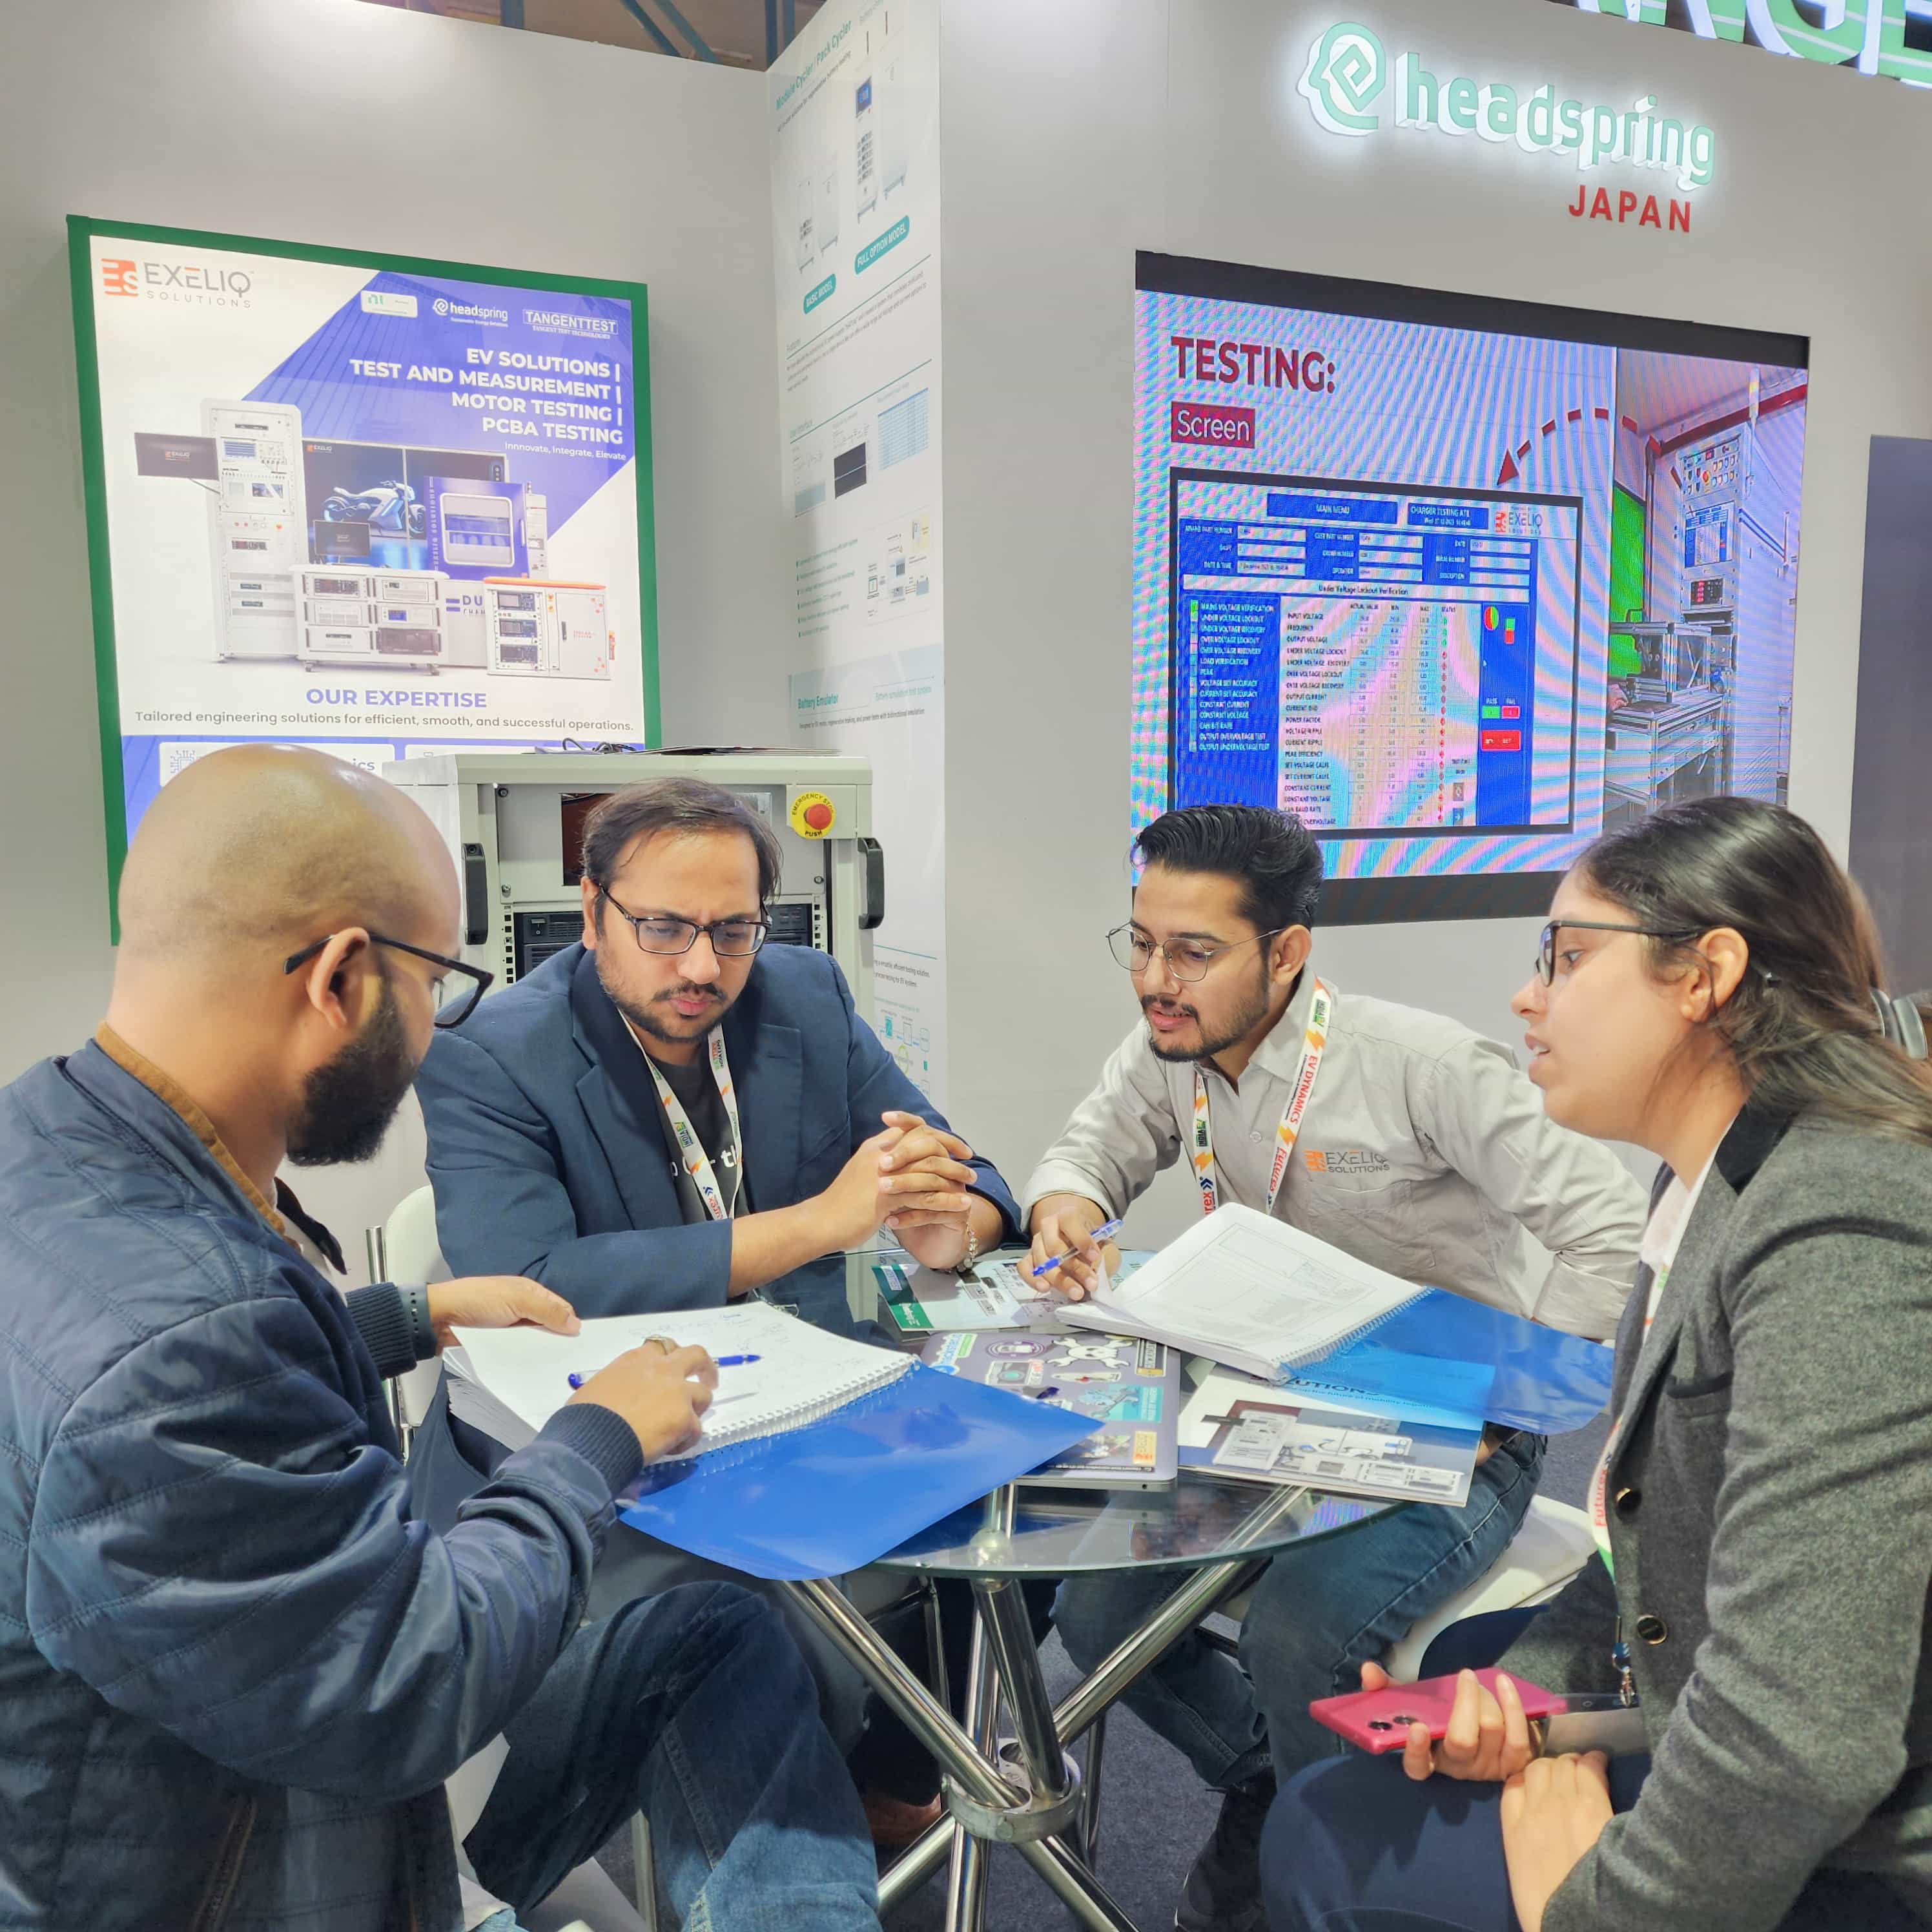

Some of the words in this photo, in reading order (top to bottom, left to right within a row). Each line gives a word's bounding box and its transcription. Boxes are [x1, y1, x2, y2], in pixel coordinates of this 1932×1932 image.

[832, 21, 851, 48] Cycler
[1395, 52, 1715, 190] headspring
[1568, 184, 1691, 233] JAPAN
[858, 252, 869, 268] FULL
[870, 237, 889, 257] OPTION
[888, 222, 906, 245] MODEL
[144, 262, 251, 297] EXELIQ
[818, 280, 832, 300] MODEL
[147, 290, 251, 309] SOLUTIONS
[450, 302, 508, 322] headspring
[526, 310, 615, 333] TANGENTTEST
[467, 348, 493, 365] EV
[498, 351, 610, 378] SOLUTIONS
[1171, 336, 1335, 394] TESTING:
[350, 359, 402, 378] TEST
[407, 364, 453, 384] AND
[460, 371, 611, 400] MEASUREMENT
[452, 393, 526, 413] MOTOR
[531, 400, 611, 422] TESTING
[483, 417, 539, 437] PCBA
[543, 422, 623, 445] TESTING
[1177, 409, 1249, 441] Screen
[553, 446, 594, 458] Integrate,
[596, 451, 626, 460] Elevate
[306, 688, 358, 705] OUR
[365, 690, 487, 708] EXPERTISE
[135, 711, 192, 723] Tailored
[196, 711, 278, 725] engineering
[281, 712, 342, 724] solutions
[344, 713, 362, 724] for
[365, 714, 420, 726] efficient,
[422, 715, 473, 727] smooth,
[476, 716, 500, 727] and
[502, 717, 566, 728] successful
[568, 719, 633, 732] operations.
[792, 794, 823, 815] EMERGENCY
[1308, 1055, 1318, 1071] EV
[1290, 1071, 1313, 1125] DYNAMICS
[1328, 1165, 1390, 1173] SOLUTIONS
[1594, 1468, 1608, 1527] Futurex
